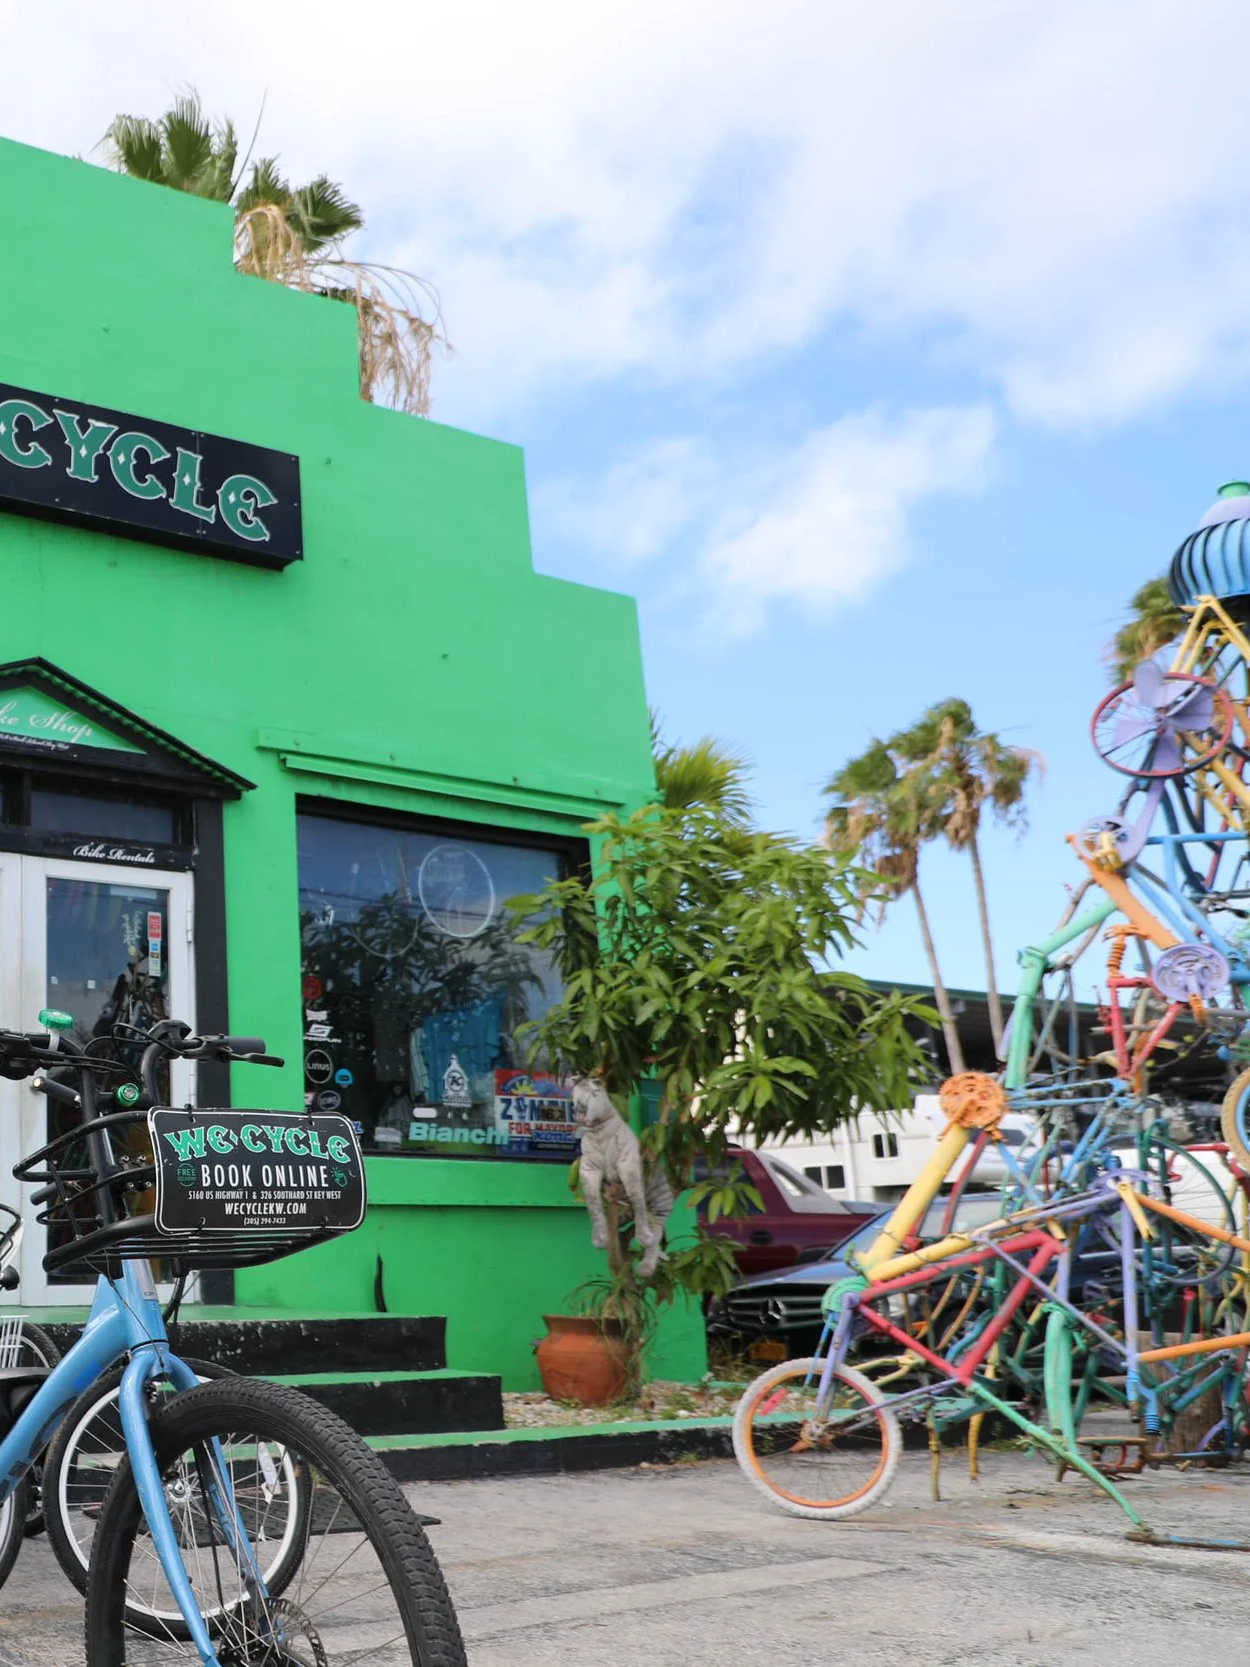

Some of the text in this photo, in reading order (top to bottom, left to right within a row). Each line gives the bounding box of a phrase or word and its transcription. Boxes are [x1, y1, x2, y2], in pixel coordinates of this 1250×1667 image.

[29, 711, 94, 743] Shop
[73, 843, 155, 863] Bike Rentals
[409, 1121, 510, 1145] Bianchi
[508, 1122, 532, 1135] FOR
[177, 1168, 197, 1176] FREE
[201, 1164, 330, 1188] BOOK ONLINE
[188, 1190, 204, 1200] 5160
[205, 1190, 214, 1200] US
[215, 1190, 243, 1200] HIGHWAY
[252, 1190, 257, 1200] &
[260, 1190, 272, 1200] 326
[273, 1190, 305, 1200] SOUTHARD
[305, 1190, 313, 1200] ST
[313, 1190, 325, 1200] KEY
[325, 1190, 342, 1200] WEST
[224, 1202, 307, 1215] WECYCLEKW.COM
[243, 1217, 286, 1226] (305) 294-7433
